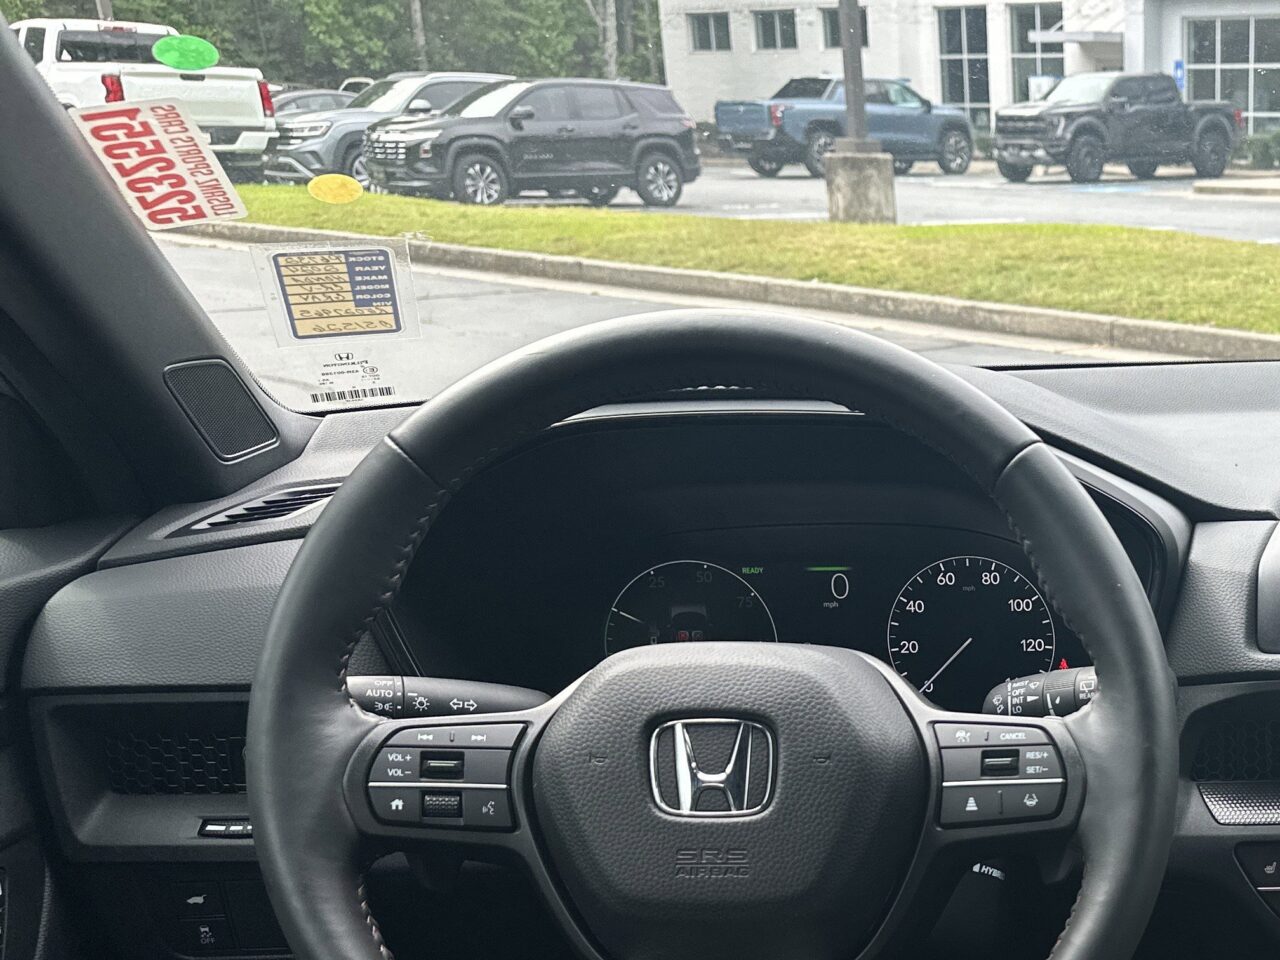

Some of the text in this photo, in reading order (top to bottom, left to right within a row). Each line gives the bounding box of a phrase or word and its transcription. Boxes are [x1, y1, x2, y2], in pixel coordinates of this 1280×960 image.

[649, 577, 665, 588] 25
[696, 571, 712, 583] 50
[937, 573, 955, 586] 60
[982, 573, 1000, 585] 80
[831, 573, 849, 599] 0
[738, 597, 753, 608] 75
[906, 600, 924, 613] 40
[1008, 599, 1032, 612] 100
[900, 641, 918, 654] 20
[1020, 639, 1044, 652] 120
[366, 689, 393, 697] AUTO
[1012, 688, 1025, 696] OFF
[1012, 696, 1023, 704] INT
[1012, 706, 1022, 714] LO
[1000, 732, 1026, 740] CANCEL
[675, 848, 748, 863] SRS
[675, 867, 750, 878] AIRBAG
